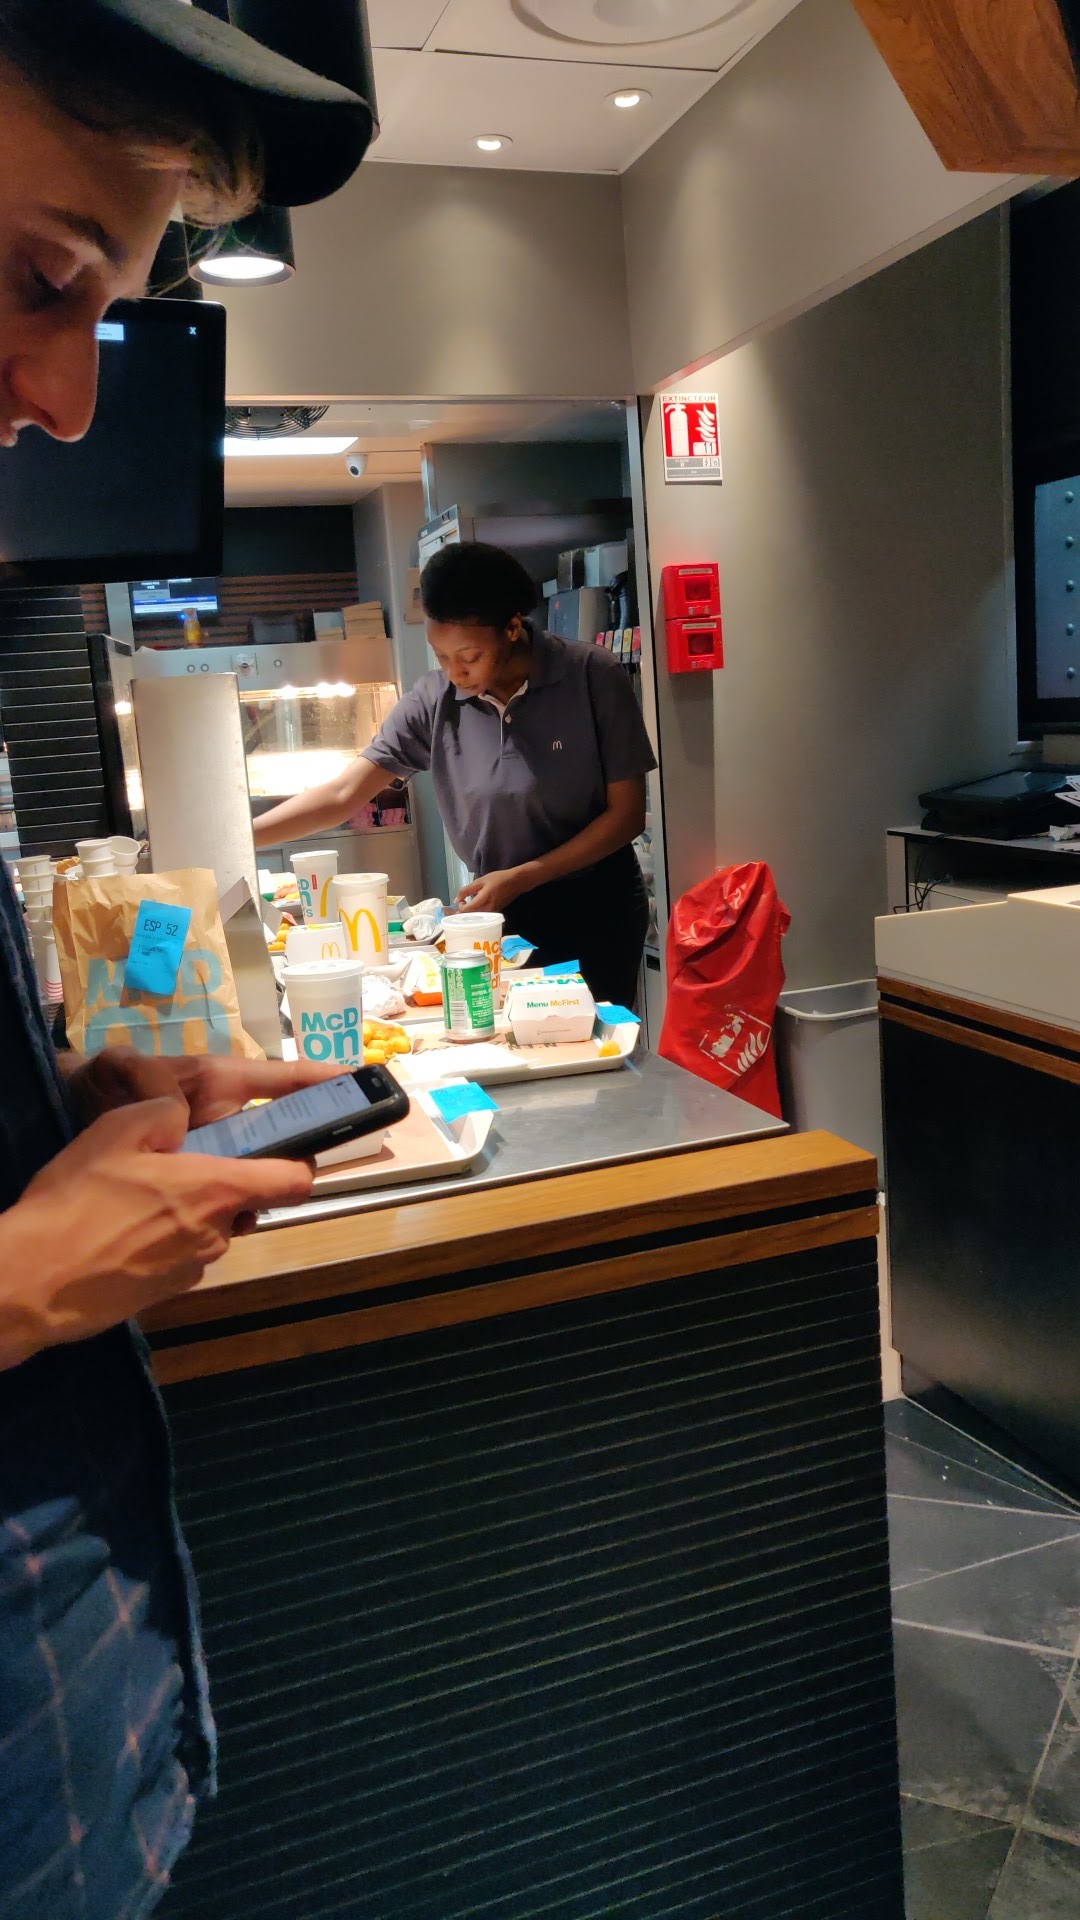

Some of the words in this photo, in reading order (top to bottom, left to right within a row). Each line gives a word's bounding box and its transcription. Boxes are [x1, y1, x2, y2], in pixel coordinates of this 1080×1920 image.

[143, 919, 162, 933] ESP
[166, 923, 179, 937] 52
[550, 999, 580, 1007] McFirst
[301, 1007, 359, 1033] McD
[303, 1028, 359, 1062] on
